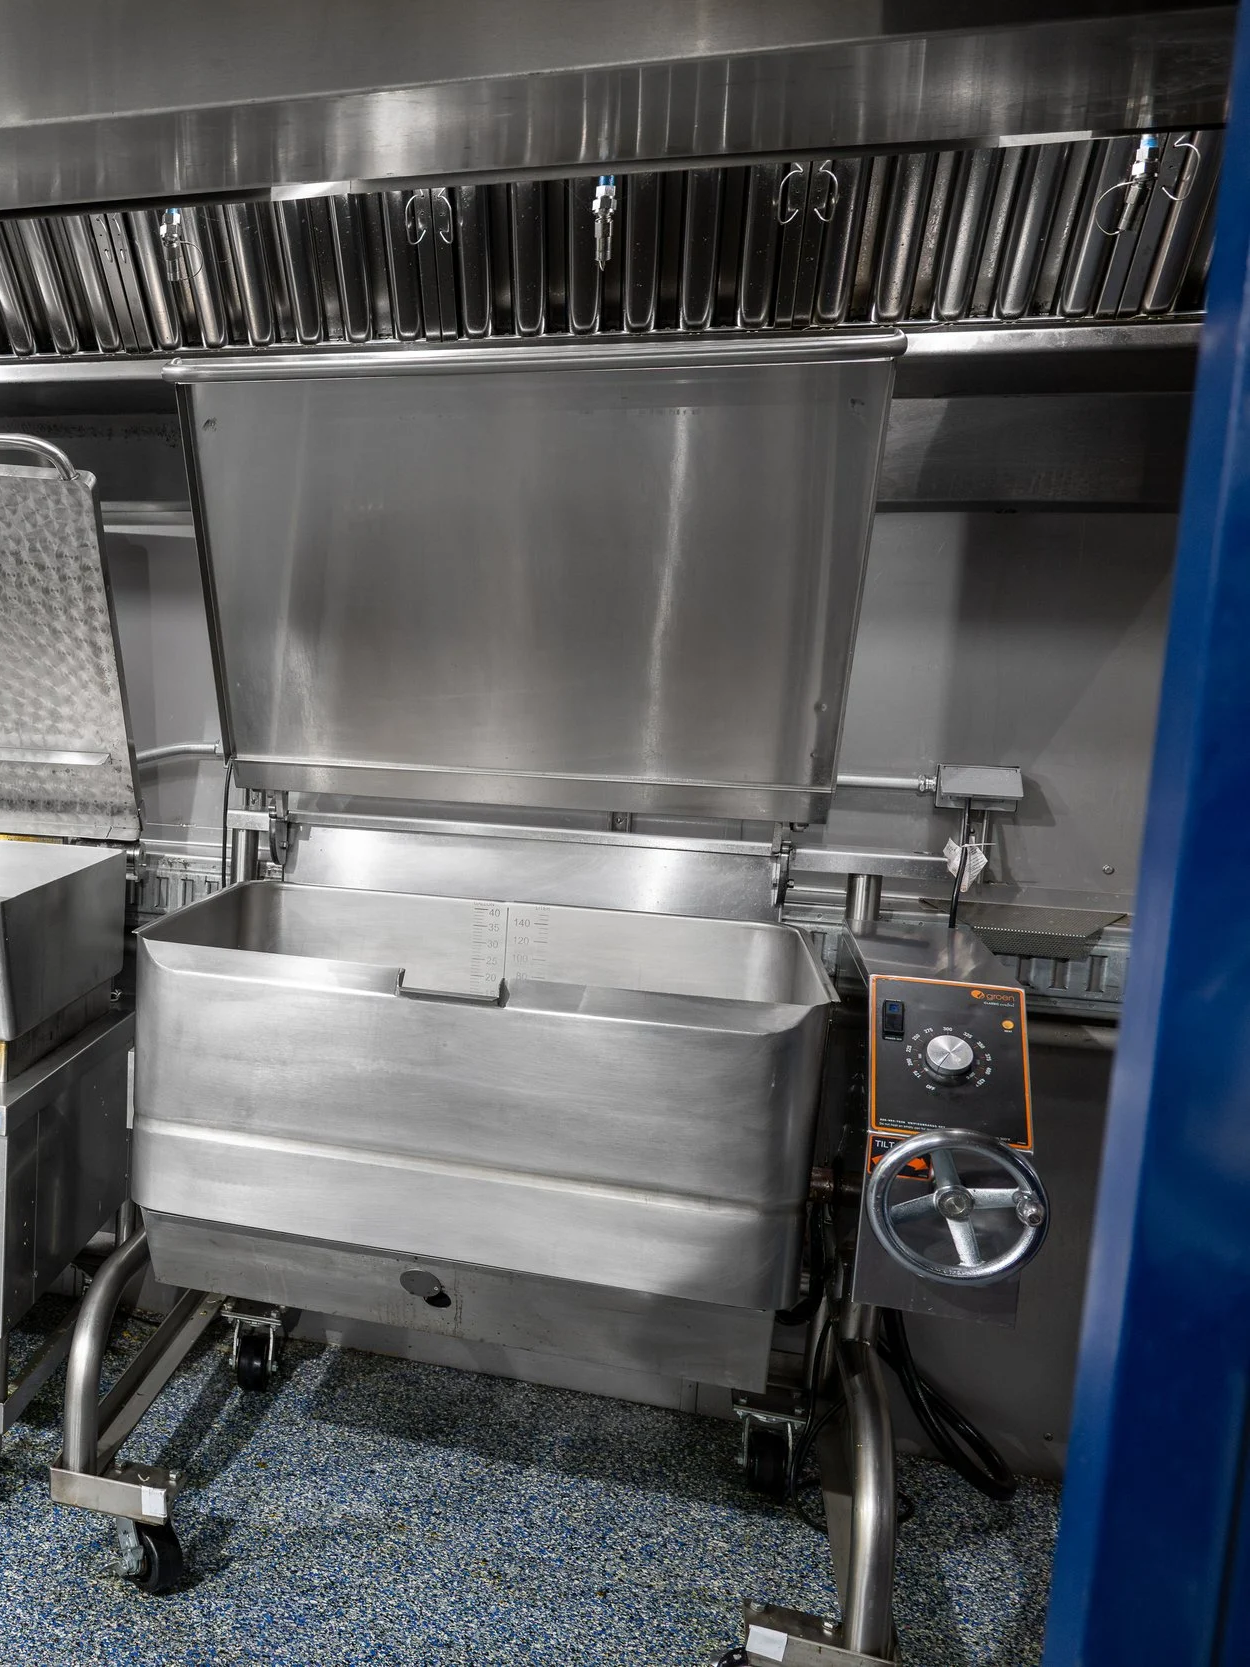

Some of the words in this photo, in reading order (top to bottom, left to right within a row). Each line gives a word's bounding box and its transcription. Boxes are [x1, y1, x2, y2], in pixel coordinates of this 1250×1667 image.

[489, 909, 500, 917] 40
[514, 918, 530, 927] 140
[488, 923, 499, 932] 35
[487, 940, 498, 948] 30
[514, 936, 529, 945] 120
[486, 957, 497, 965] 25
[512, 954, 528, 962] 100
[485, 974, 496, 982] 20
[986, 993, 1015, 1001] groen
